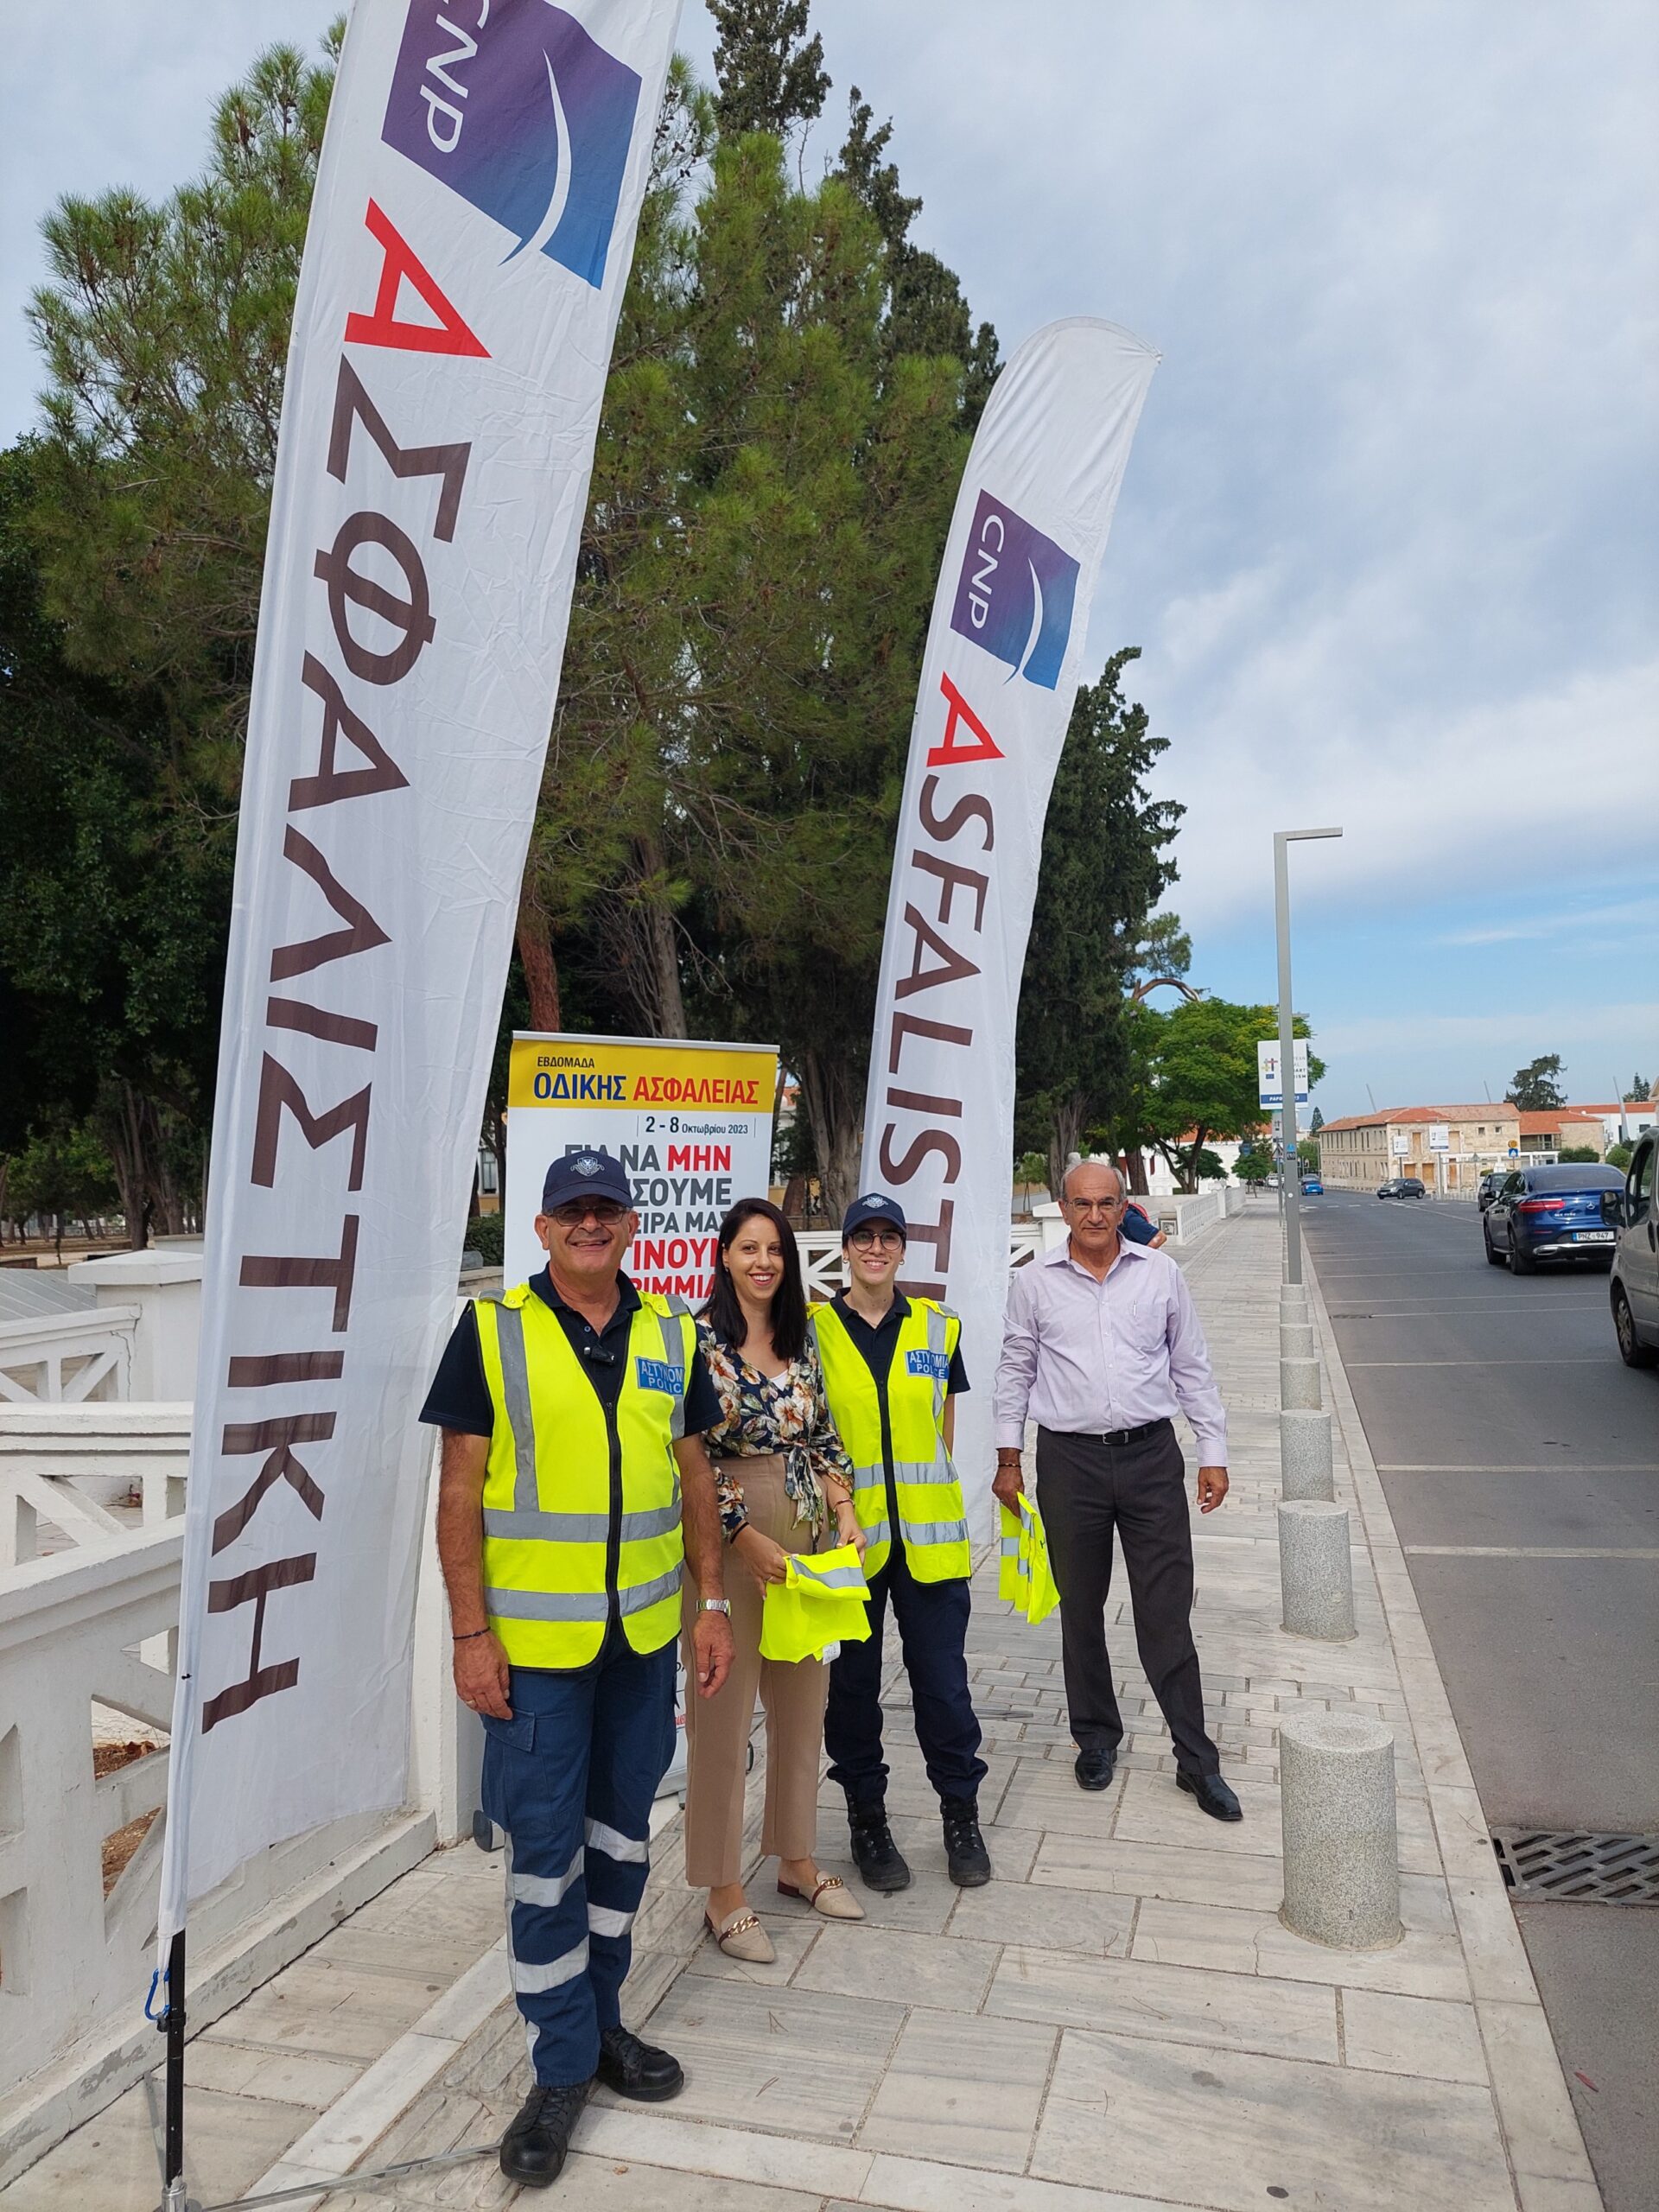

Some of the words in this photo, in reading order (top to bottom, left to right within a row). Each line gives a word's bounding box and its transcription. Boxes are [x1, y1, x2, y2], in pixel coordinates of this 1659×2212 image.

[969, 514, 1005, 629] CNP
[202, 196, 493, 1734] ΑΣΦΑΛΙΣΤΙΚΗ
[537, 1056, 595, 1069] ΕΒΔΟΜΑΔΑ
[533, 1072, 626, 1101] ΟΔΙΚΗΣ
[632, 1076, 760, 1105] ΑΣΦΑΛΕΙΑΣ
[645, 1116, 655, 1133] 2
[669, 1117, 679, 1134] 8
[682, 1123, 727, 1136] Οκτωβρίου
[728, 1124, 748, 1135] 2023
[620, 1144, 660, 1172] ΝΑ
[668, 1145, 731, 1172] ΜΗΝ
[627, 1178, 732, 1206] ΣΟΥΜΕ
[633, 1237, 719, 1270] ΙΝΟΥ
